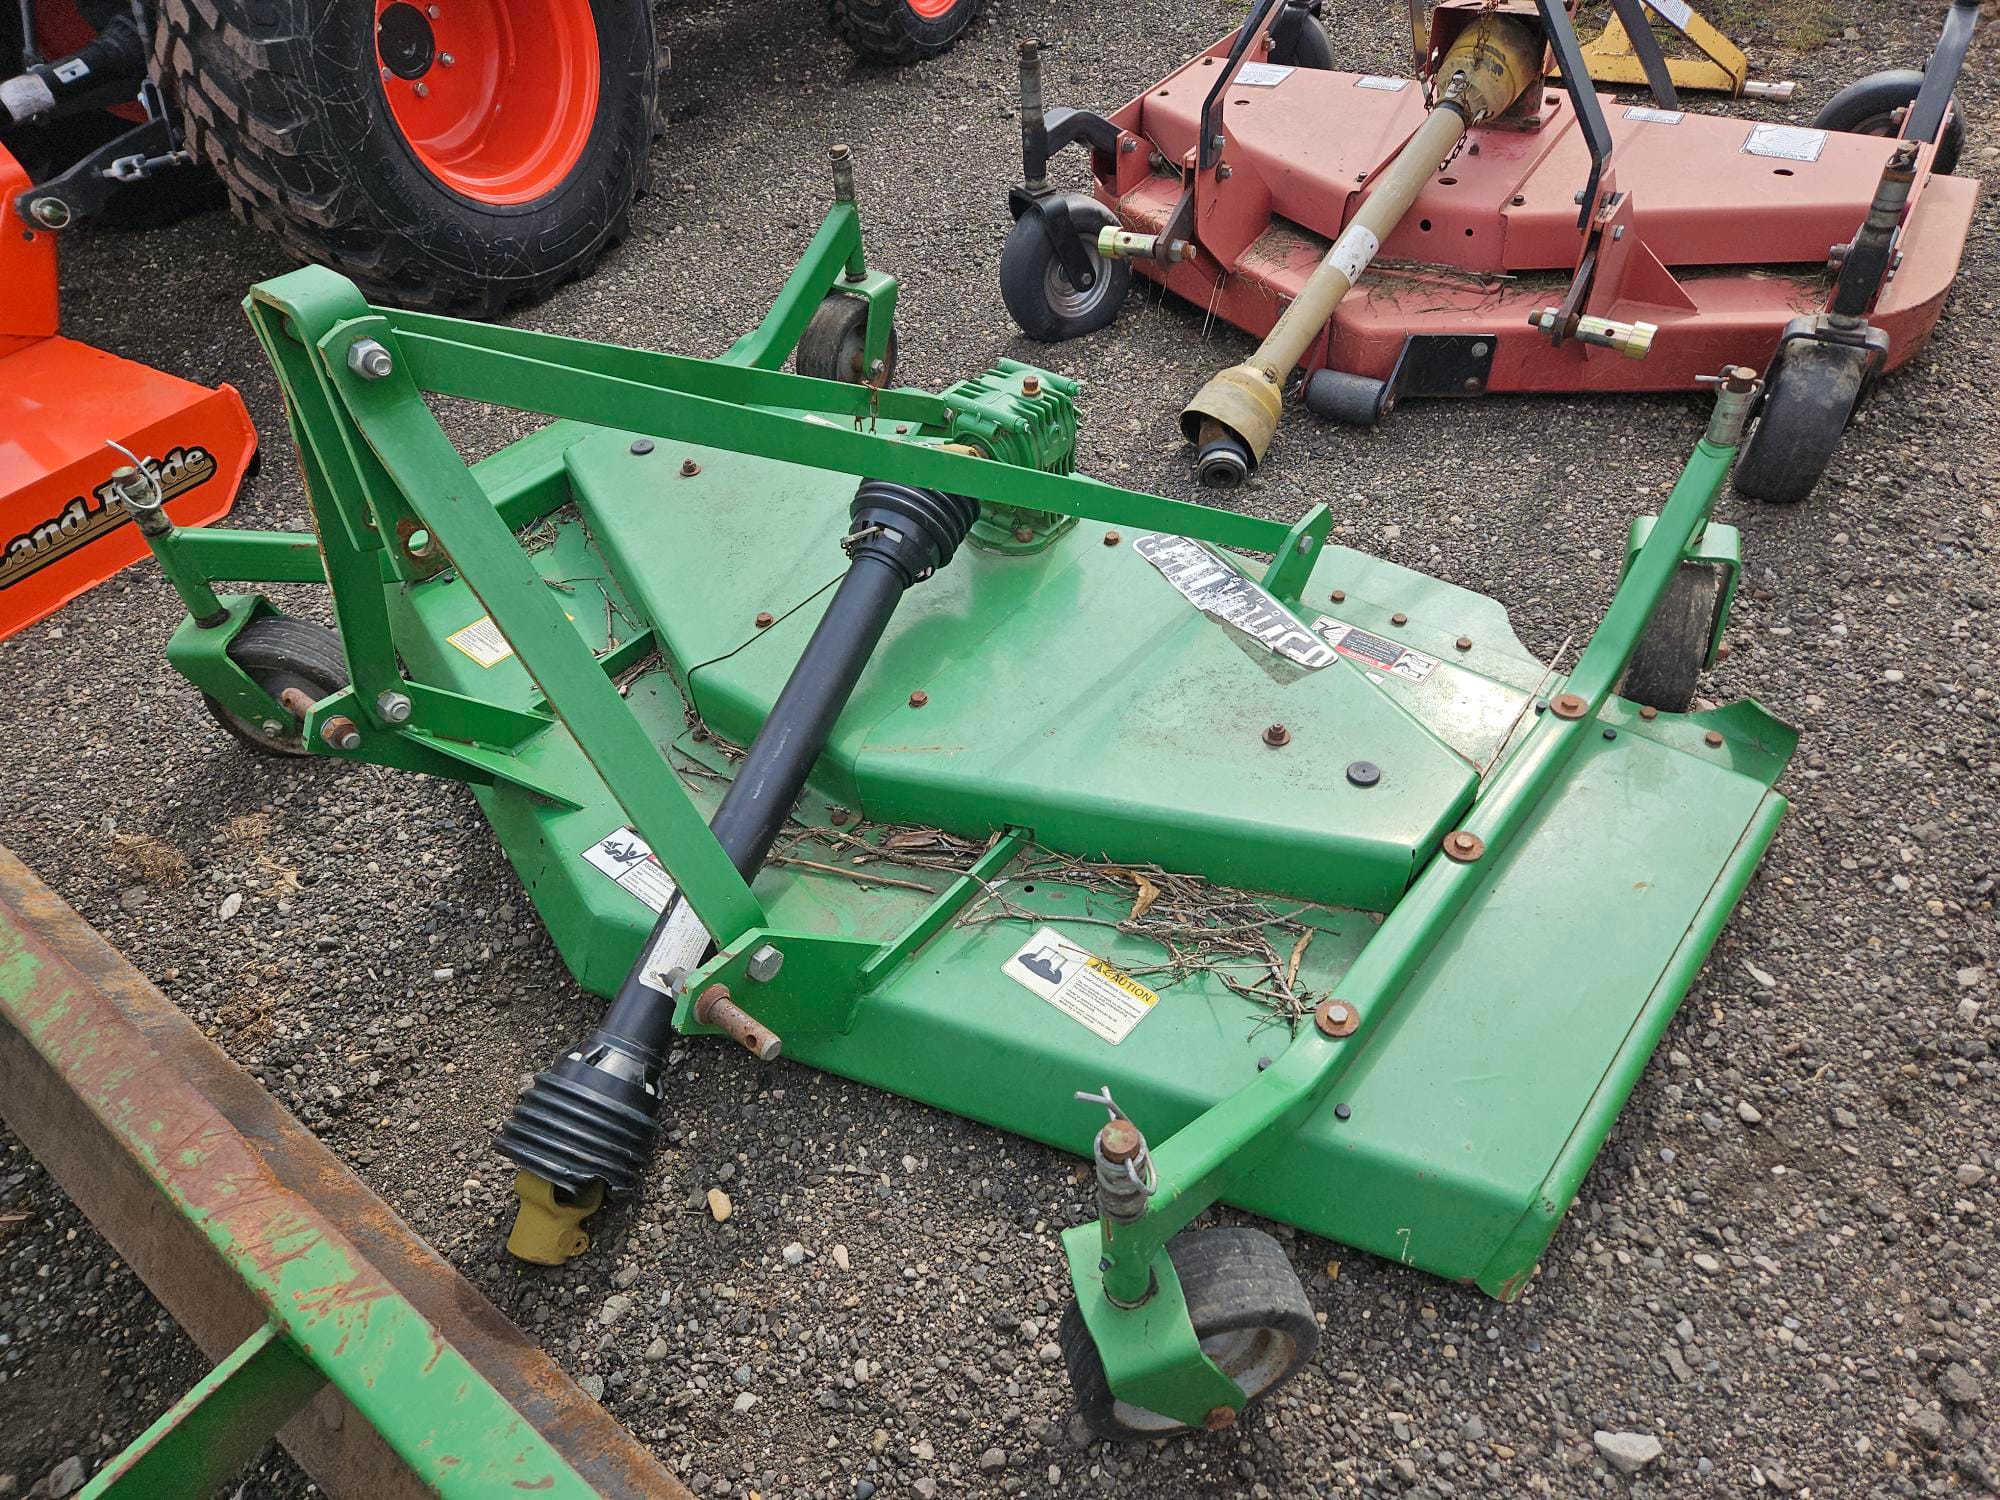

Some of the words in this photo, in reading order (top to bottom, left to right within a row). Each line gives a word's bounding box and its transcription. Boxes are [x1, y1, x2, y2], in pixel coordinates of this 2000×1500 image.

[0, 500, 91, 571] and
[1347, 650, 1374, 663] DANGER
[1103, 969, 1153, 1002] CAUTION
